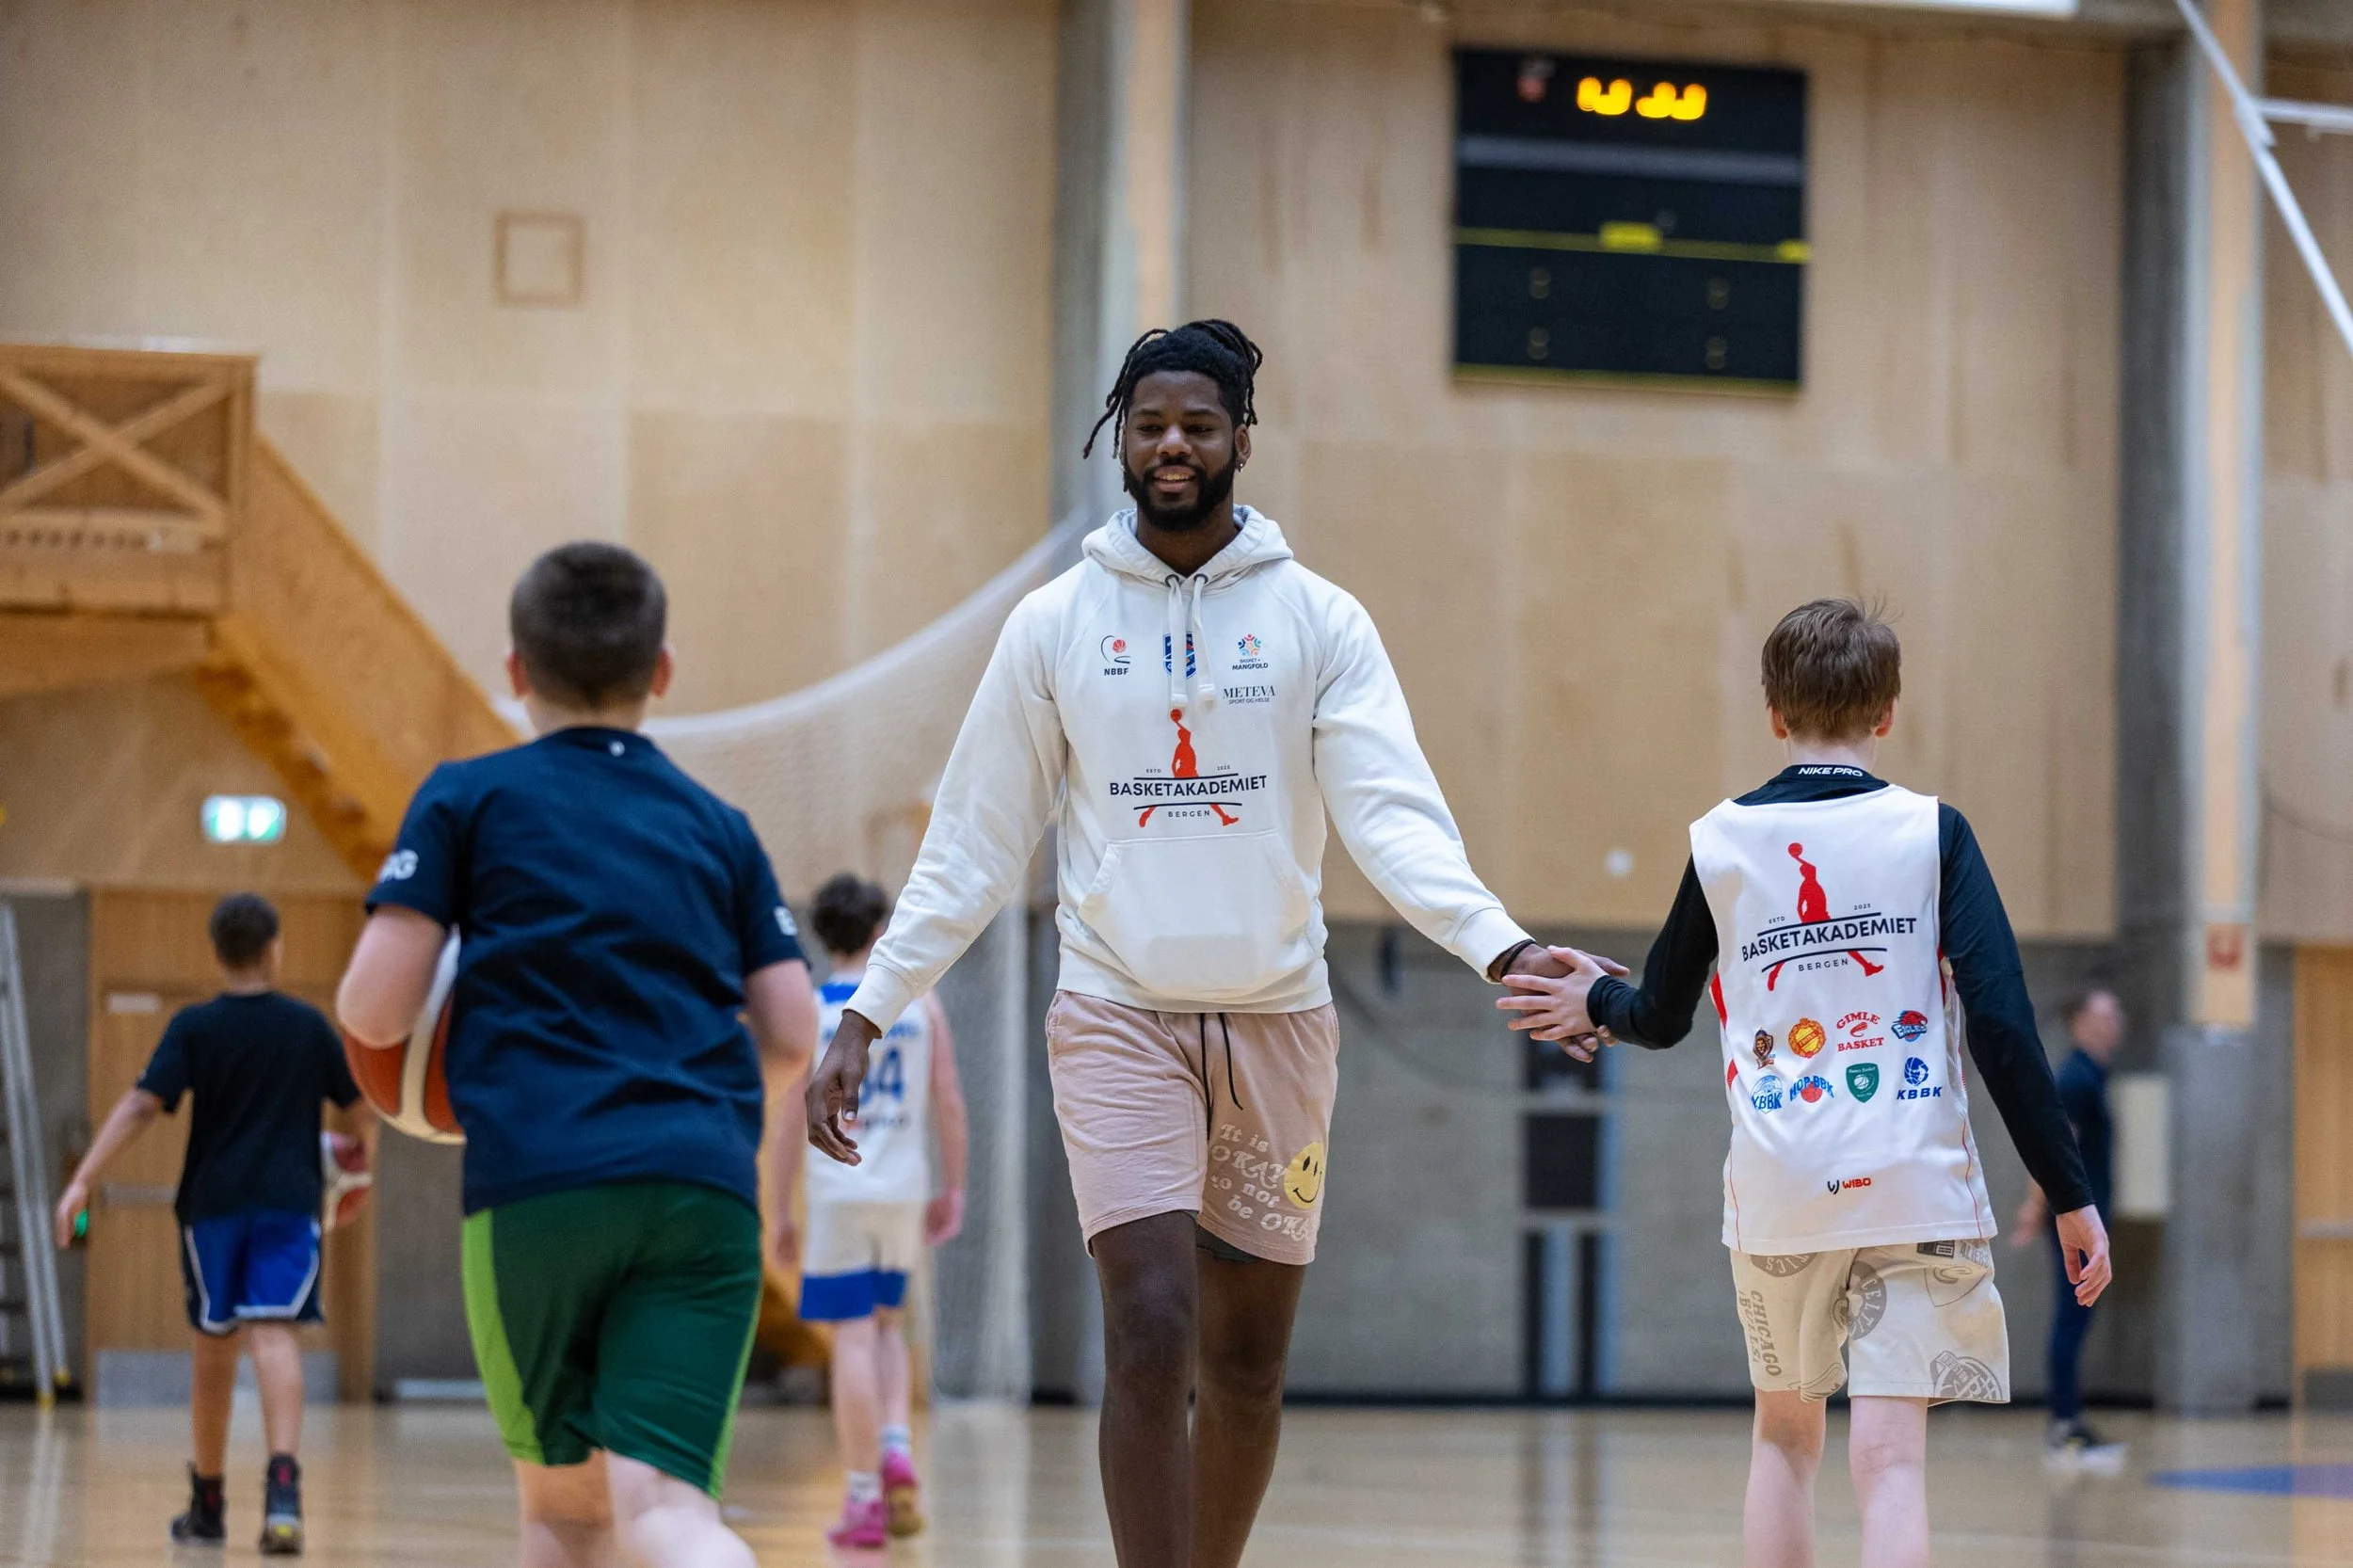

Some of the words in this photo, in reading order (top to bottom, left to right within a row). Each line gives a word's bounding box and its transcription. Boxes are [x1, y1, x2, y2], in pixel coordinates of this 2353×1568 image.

[1104, 667, 1129, 677] NBBF
[1224, 684, 1275, 699] METEVA
[1798, 767, 1832, 776] NIKE
[1832, 767, 1864, 777] PRO
[1109, 776, 1268, 796] BASKETAKADEMIET
[1168, 809, 1210, 818] BERGEN
[1768, 915, 1786, 925] ESTD
[1741, 917, 1917, 962] BASKETAKADEMIET
[1798, 958, 1849, 972] BERGEN
[1836, 1011, 1881, 1030] GIMLE
[1837, 1036, 1884, 1052] BASKET
[1896, 1086, 1943, 1100] KBBK
[1220, 1124, 1243, 1143] It
[1248, 1134, 1269, 1152] is
[1211, 1144, 1289, 1190] OKAY
[1842, 1177, 1871, 1189] WIBO
[1241, 1183, 1281, 1208] not
[1227, 1194, 1254, 1219] be
[1751, 1289, 1782, 1376] CHICAGO
